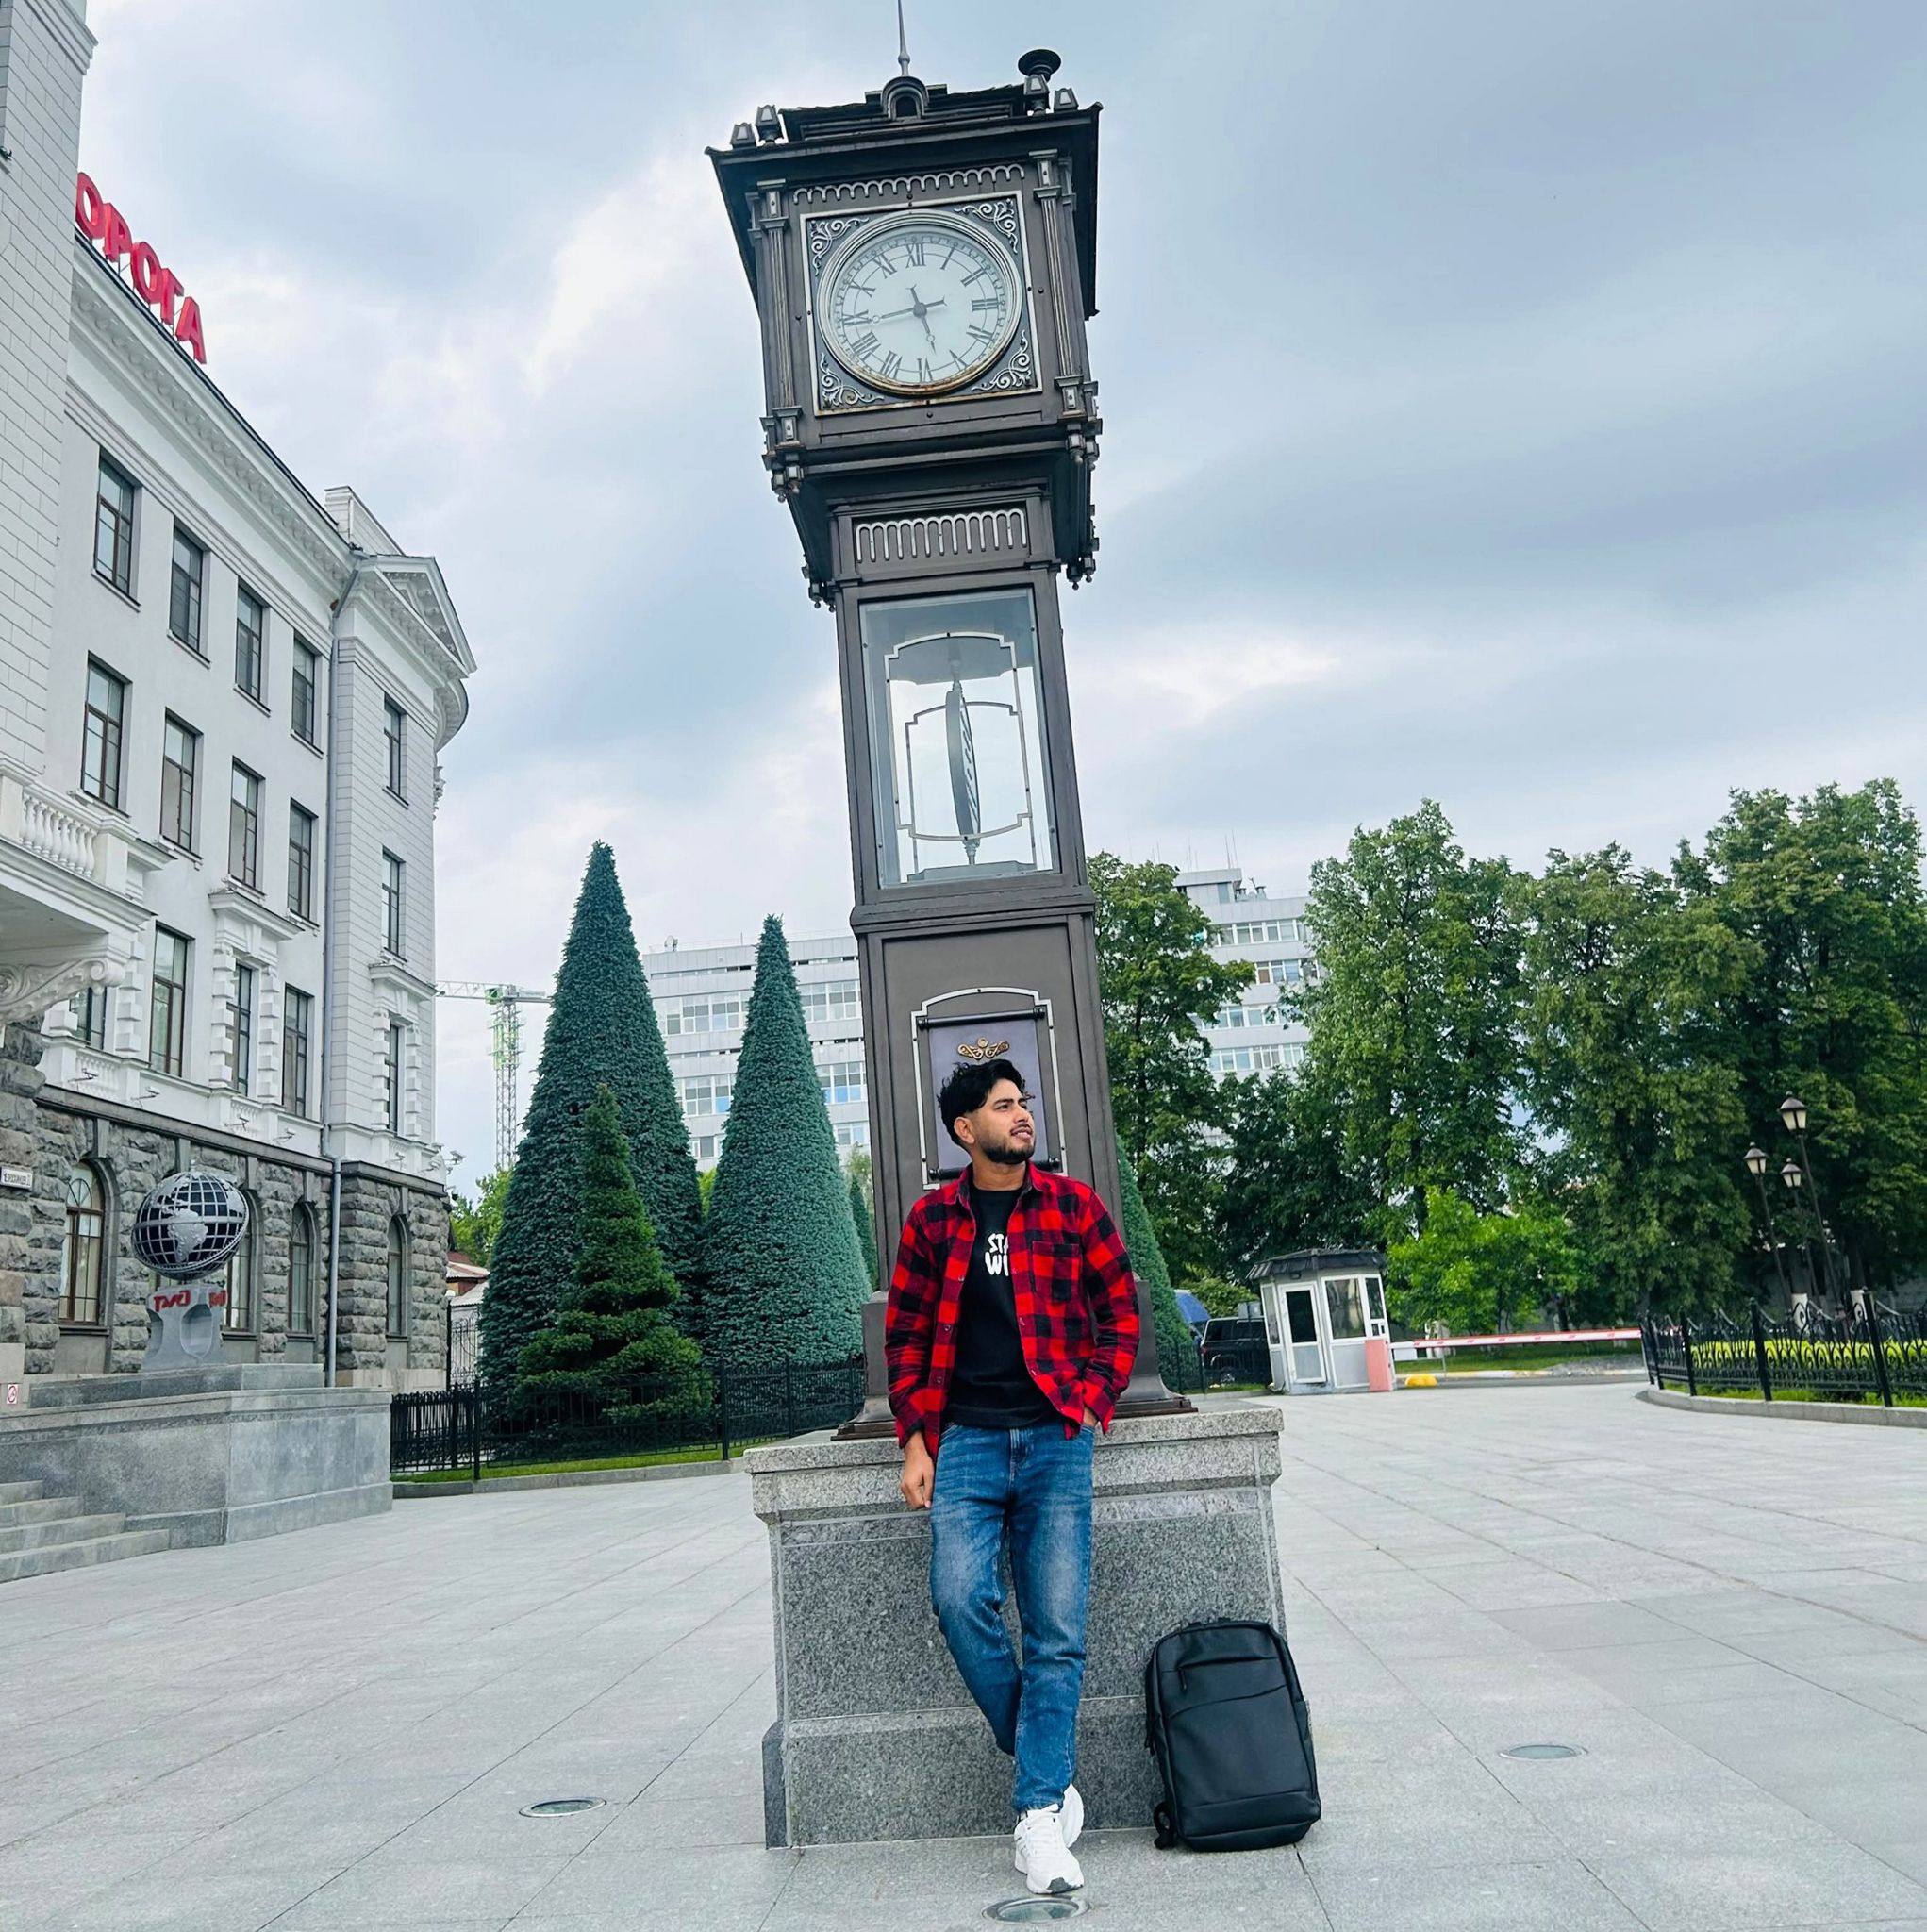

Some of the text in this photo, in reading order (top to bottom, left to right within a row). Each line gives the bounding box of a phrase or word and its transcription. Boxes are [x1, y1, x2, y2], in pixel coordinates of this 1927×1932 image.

[872, 253, 897, 279] XI
[905, 243, 926, 269] XII
[849, 280, 875, 298] X
[961, 268, 986, 287] II
[971, 298, 999, 312] III
[852, 331, 881, 361] VIII
[880, 350, 902, 379] VII
[917, 358, 933, 383] VI
[949, 349, 969, 372] V
